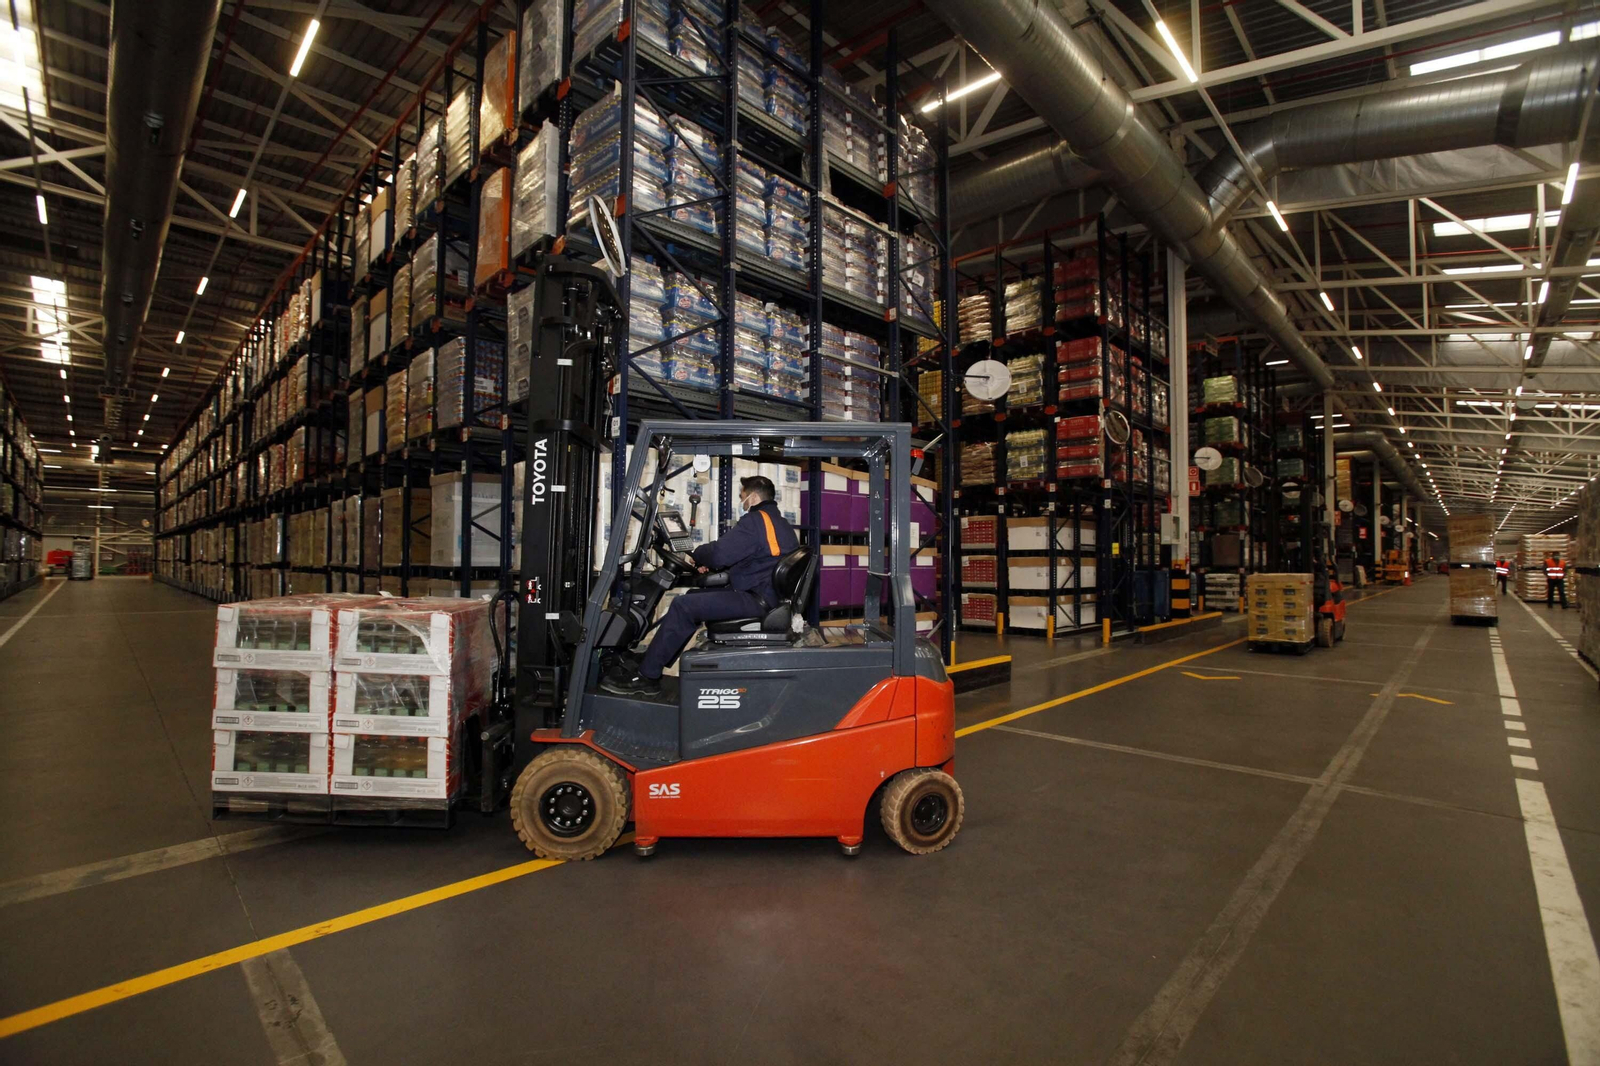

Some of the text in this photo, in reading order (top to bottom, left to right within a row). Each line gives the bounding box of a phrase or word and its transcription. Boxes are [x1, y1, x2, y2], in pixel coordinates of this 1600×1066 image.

[532, 438, 548, 505] TOYOTA
[698, 696, 740, 708] 25
[648, 783, 680, 795] SAS
